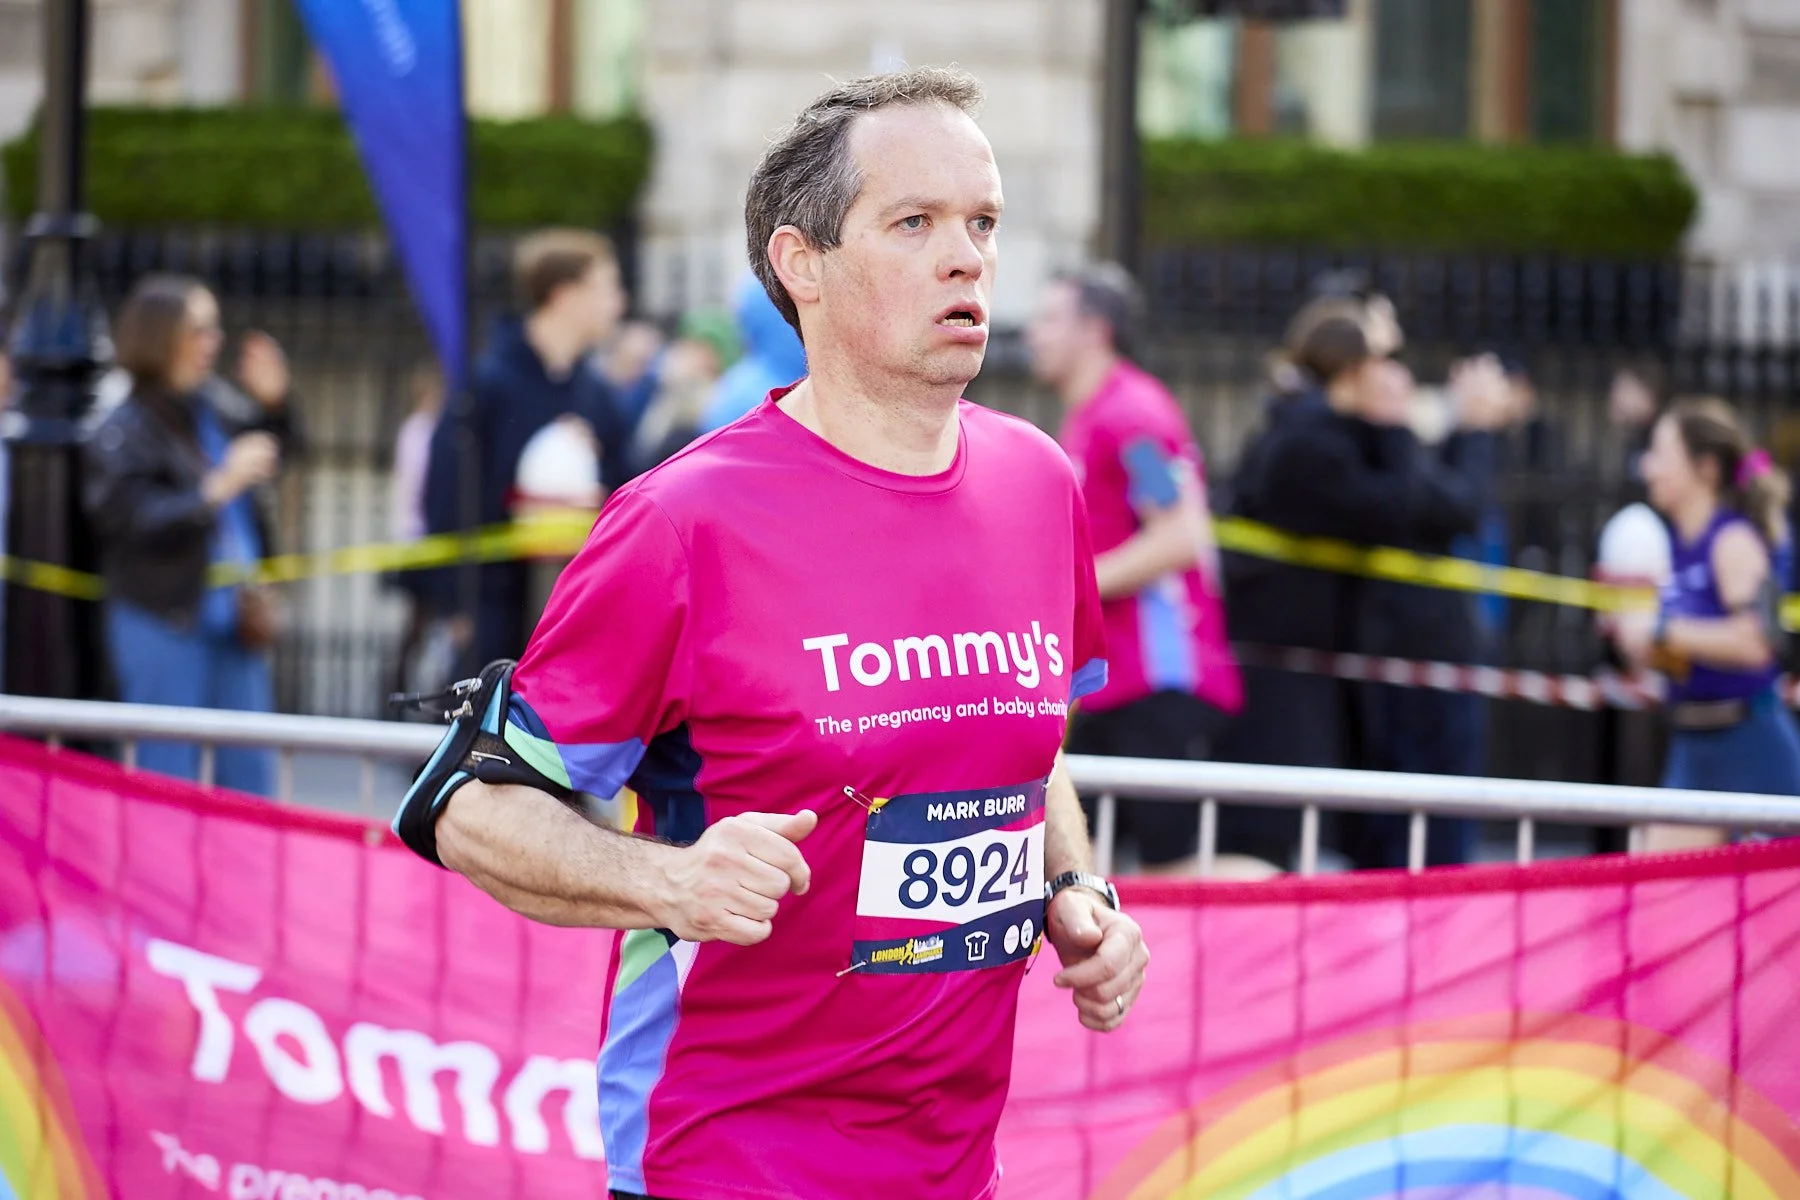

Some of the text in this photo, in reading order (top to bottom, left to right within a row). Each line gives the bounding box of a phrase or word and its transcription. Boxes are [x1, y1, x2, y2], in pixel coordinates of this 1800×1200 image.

[803, 621, 1064, 691] Tommy's
[815, 716, 852, 735] The
[858, 704, 951, 734] pregnancy
[955, 698, 988, 718] and
[993, 696, 1035, 718] baby
[927, 794, 1026, 821] MARK BURR
[898, 837, 1029, 909] 8924
[871, 946, 905, 963] LONDON
